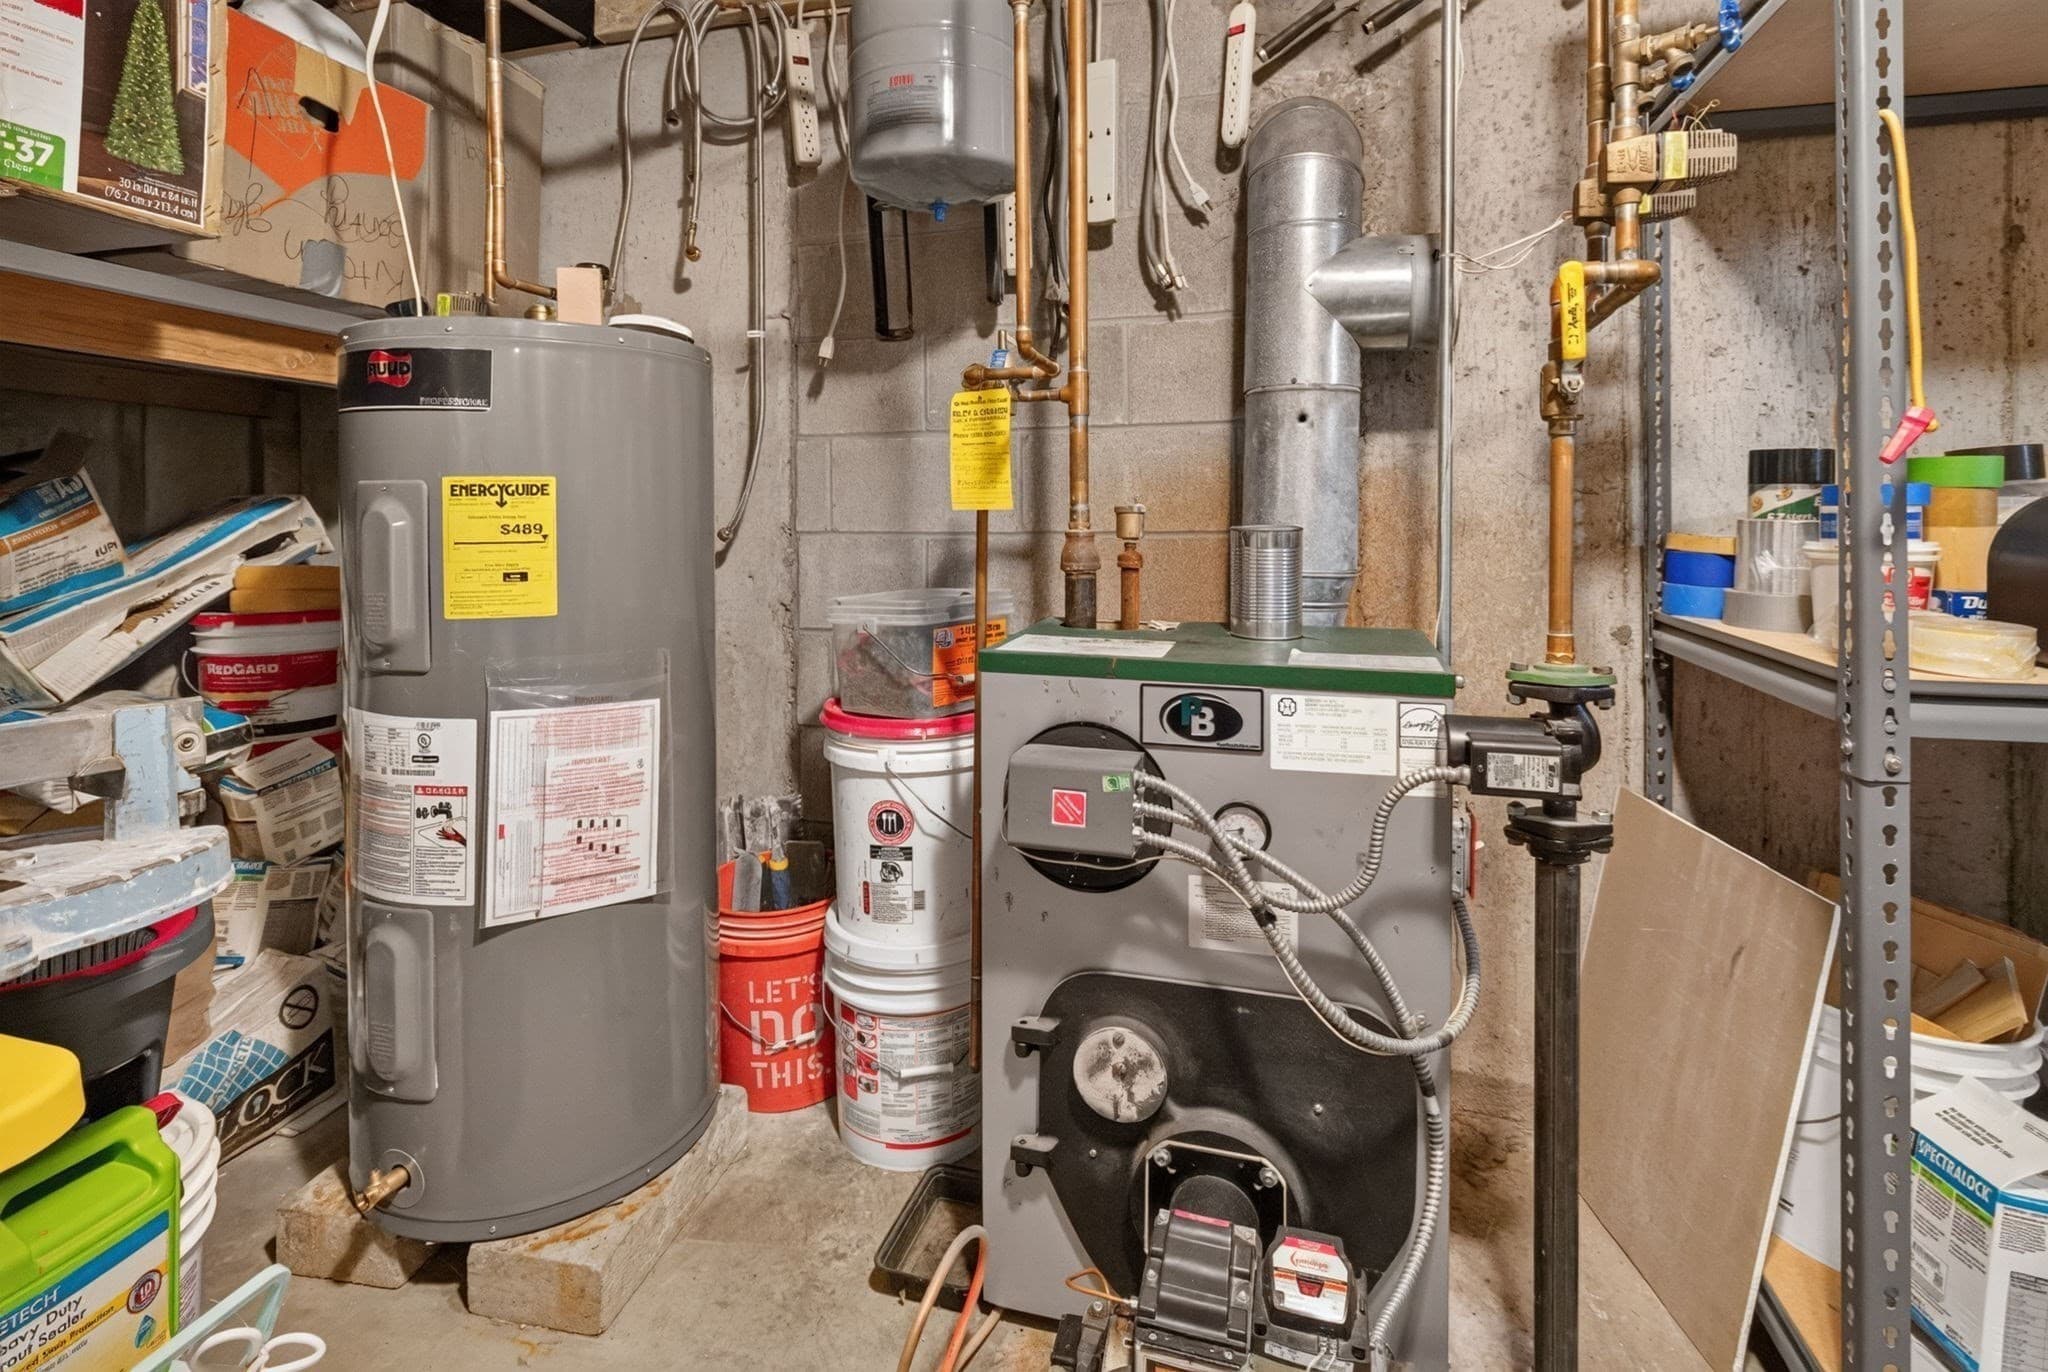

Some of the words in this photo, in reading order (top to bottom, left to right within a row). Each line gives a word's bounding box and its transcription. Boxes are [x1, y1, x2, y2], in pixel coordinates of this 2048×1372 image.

[368, 361, 411, 376] RUUD
[450, 484, 549, 497] ENERGYGUIDE
[750, 1052, 824, 1089] THIS
[1919, 1140, 1992, 1202] SPECTRALOCK
[46, 1296, 82, 1326] Duty
[38, 1309, 87, 1348] Sealer
